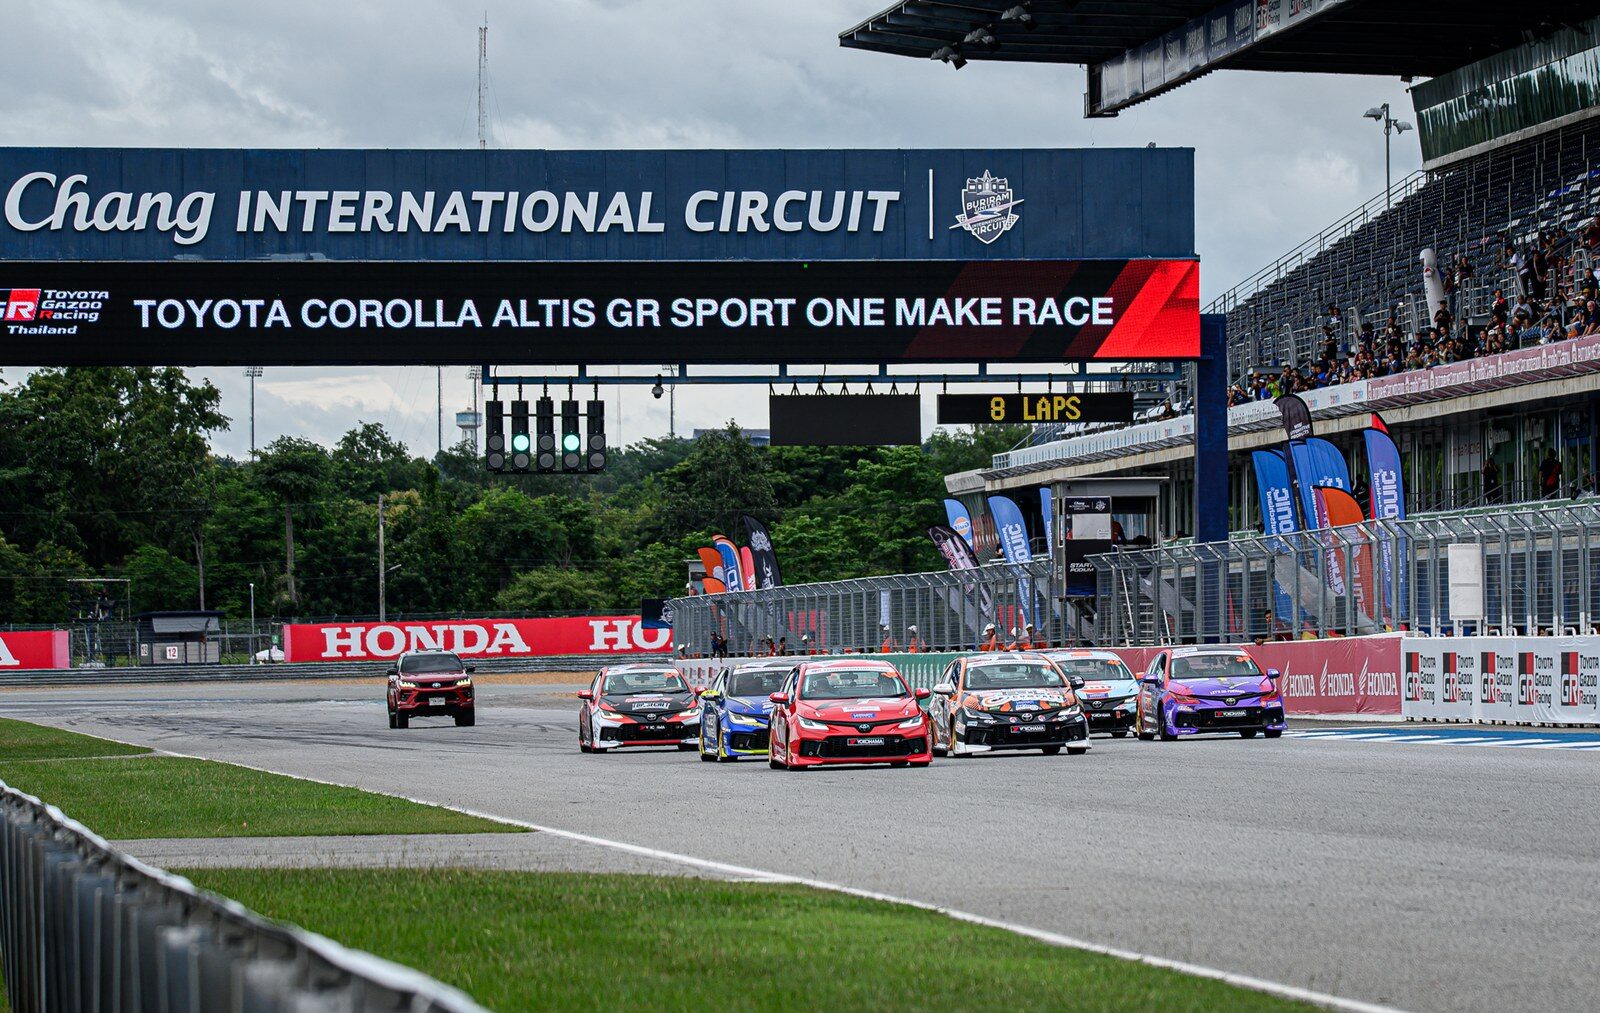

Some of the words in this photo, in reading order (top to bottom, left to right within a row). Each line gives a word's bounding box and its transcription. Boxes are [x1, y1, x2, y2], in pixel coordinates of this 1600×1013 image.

[5, 171, 216, 244] Chang
[236, 190, 666, 233] INTERNATIONAL
[685, 190, 900, 232] CIRCUIT
[966, 192, 1010, 211] BURIRAM
[972, 220, 1006, 235] CIRCUIT
[44, 289, 109, 299] TOYOTA
[0, 301, 35, 319] R
[41, 300, 102, 310] GAZOO
[133, 298, 292, 329] TOYOTA
[301, 298, 483, 329] COROLLA
[492, 298, 596, 328] ALTIS
[606, 298, 661, 328] GR
[670, 298, 797, 327] SPORT
[806, 297, 885, 327] ONE
[895, 297, 1002, 326] MAKE
[1012, 297, 1114, 326] RACE
[39, 309, 100, 322] Racing
[7, 325, 78, 335] Thailand
[990, 396, 1006, 421] 8
[1023, 396, 1082, 421] LAPS
[321, 622, 531, 658] HONDA
[168, 647, 177, 658] 12
[1420, 655, 1436, 668] TOYOTA
[1458, 655, 1474, 668] TOYOTA
[1496, 655, 1514, 669] TOYOTA
[1535, 655, 1554, 670] TOYOTA
[1579, 655, 1600, 670] TOYOTA
[1289, 674, 1316, 697] HONDA
[1327, 673, 1355, 696] HONDA
[1367, 672, 1398, 696] HONDA
[1406, 672, 1420, 700] GR
[1420, 671, 1435, 685] GAZOO
[1443, 672, 1457, 700] GR
[1458, 672, 1473, 685] GAZOO
[1497, 672, 1513, 686] GAZOO
[1535, 673, 1552, 687] GAZOO
[1580, 674, 1597, 687] GAZOO
[1481, 673, 1495, 701] GR
[1518, 674, 1534, 702] GR
[1561, 674, 1578, 704] GR
[1420, 688, 1435, 705] Racing
[1458, 688, 1473, 705] Racing
[1496, 688, 1513, 707] Racing
[1535, 690, 1552, 708] Racing
[1580, 691, 1597, 710] Racing
